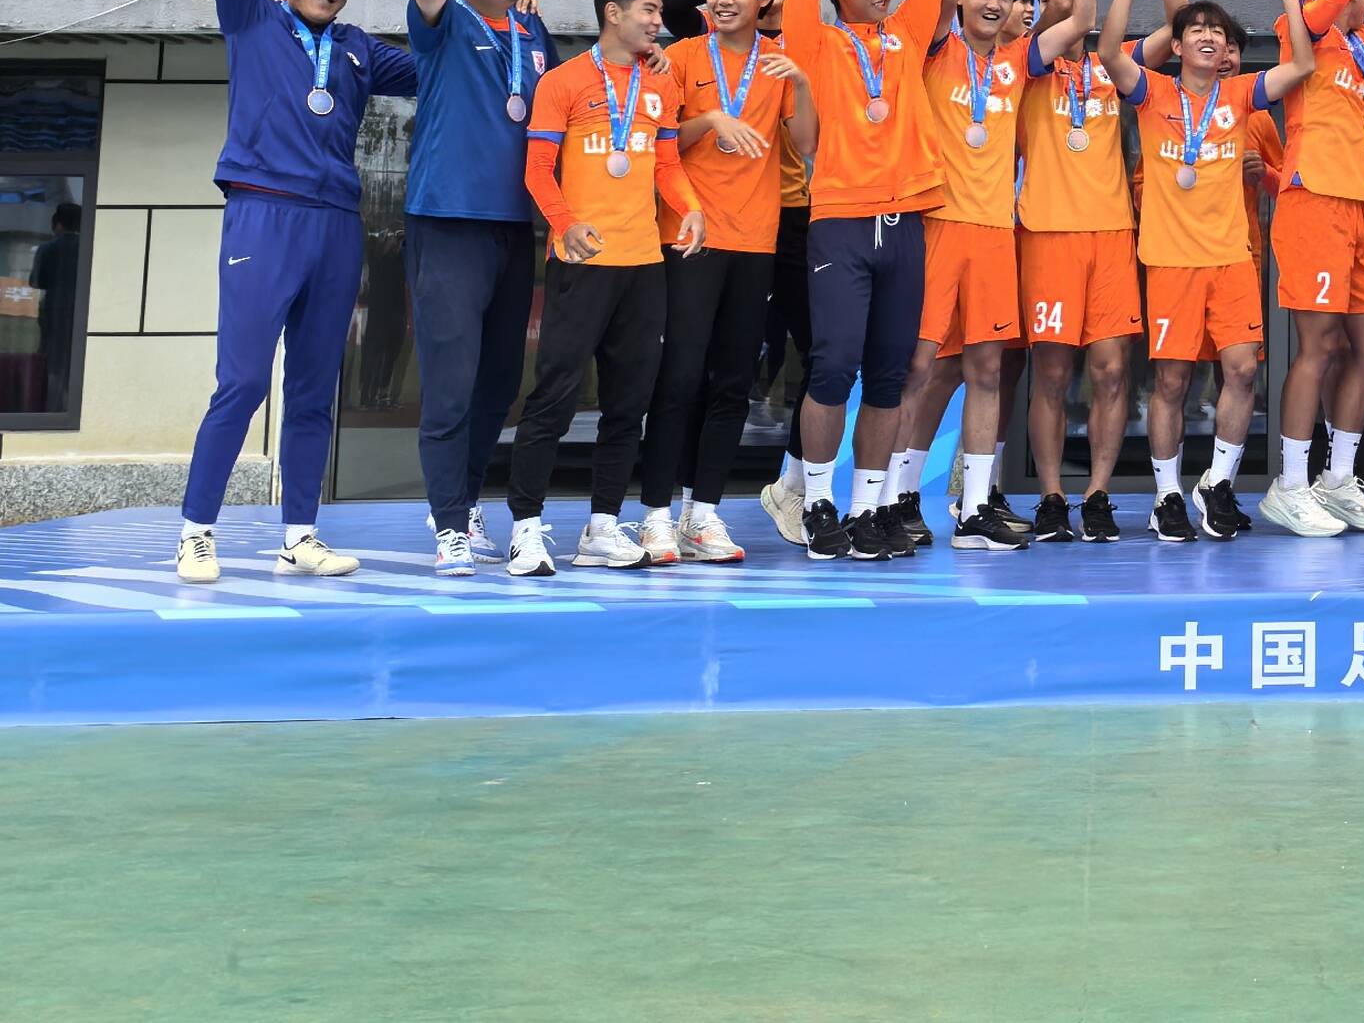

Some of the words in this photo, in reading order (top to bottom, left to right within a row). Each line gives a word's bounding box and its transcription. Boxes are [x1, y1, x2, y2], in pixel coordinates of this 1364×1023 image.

[1053, 96, 1119, 117] 山泰山
[1159, 140, 1236, 161] 山泰山
[1315, 271, 1331, 305] 2
[1033, 301, 1063, 335] 34
[1156, 318, 1170, 352] 7
